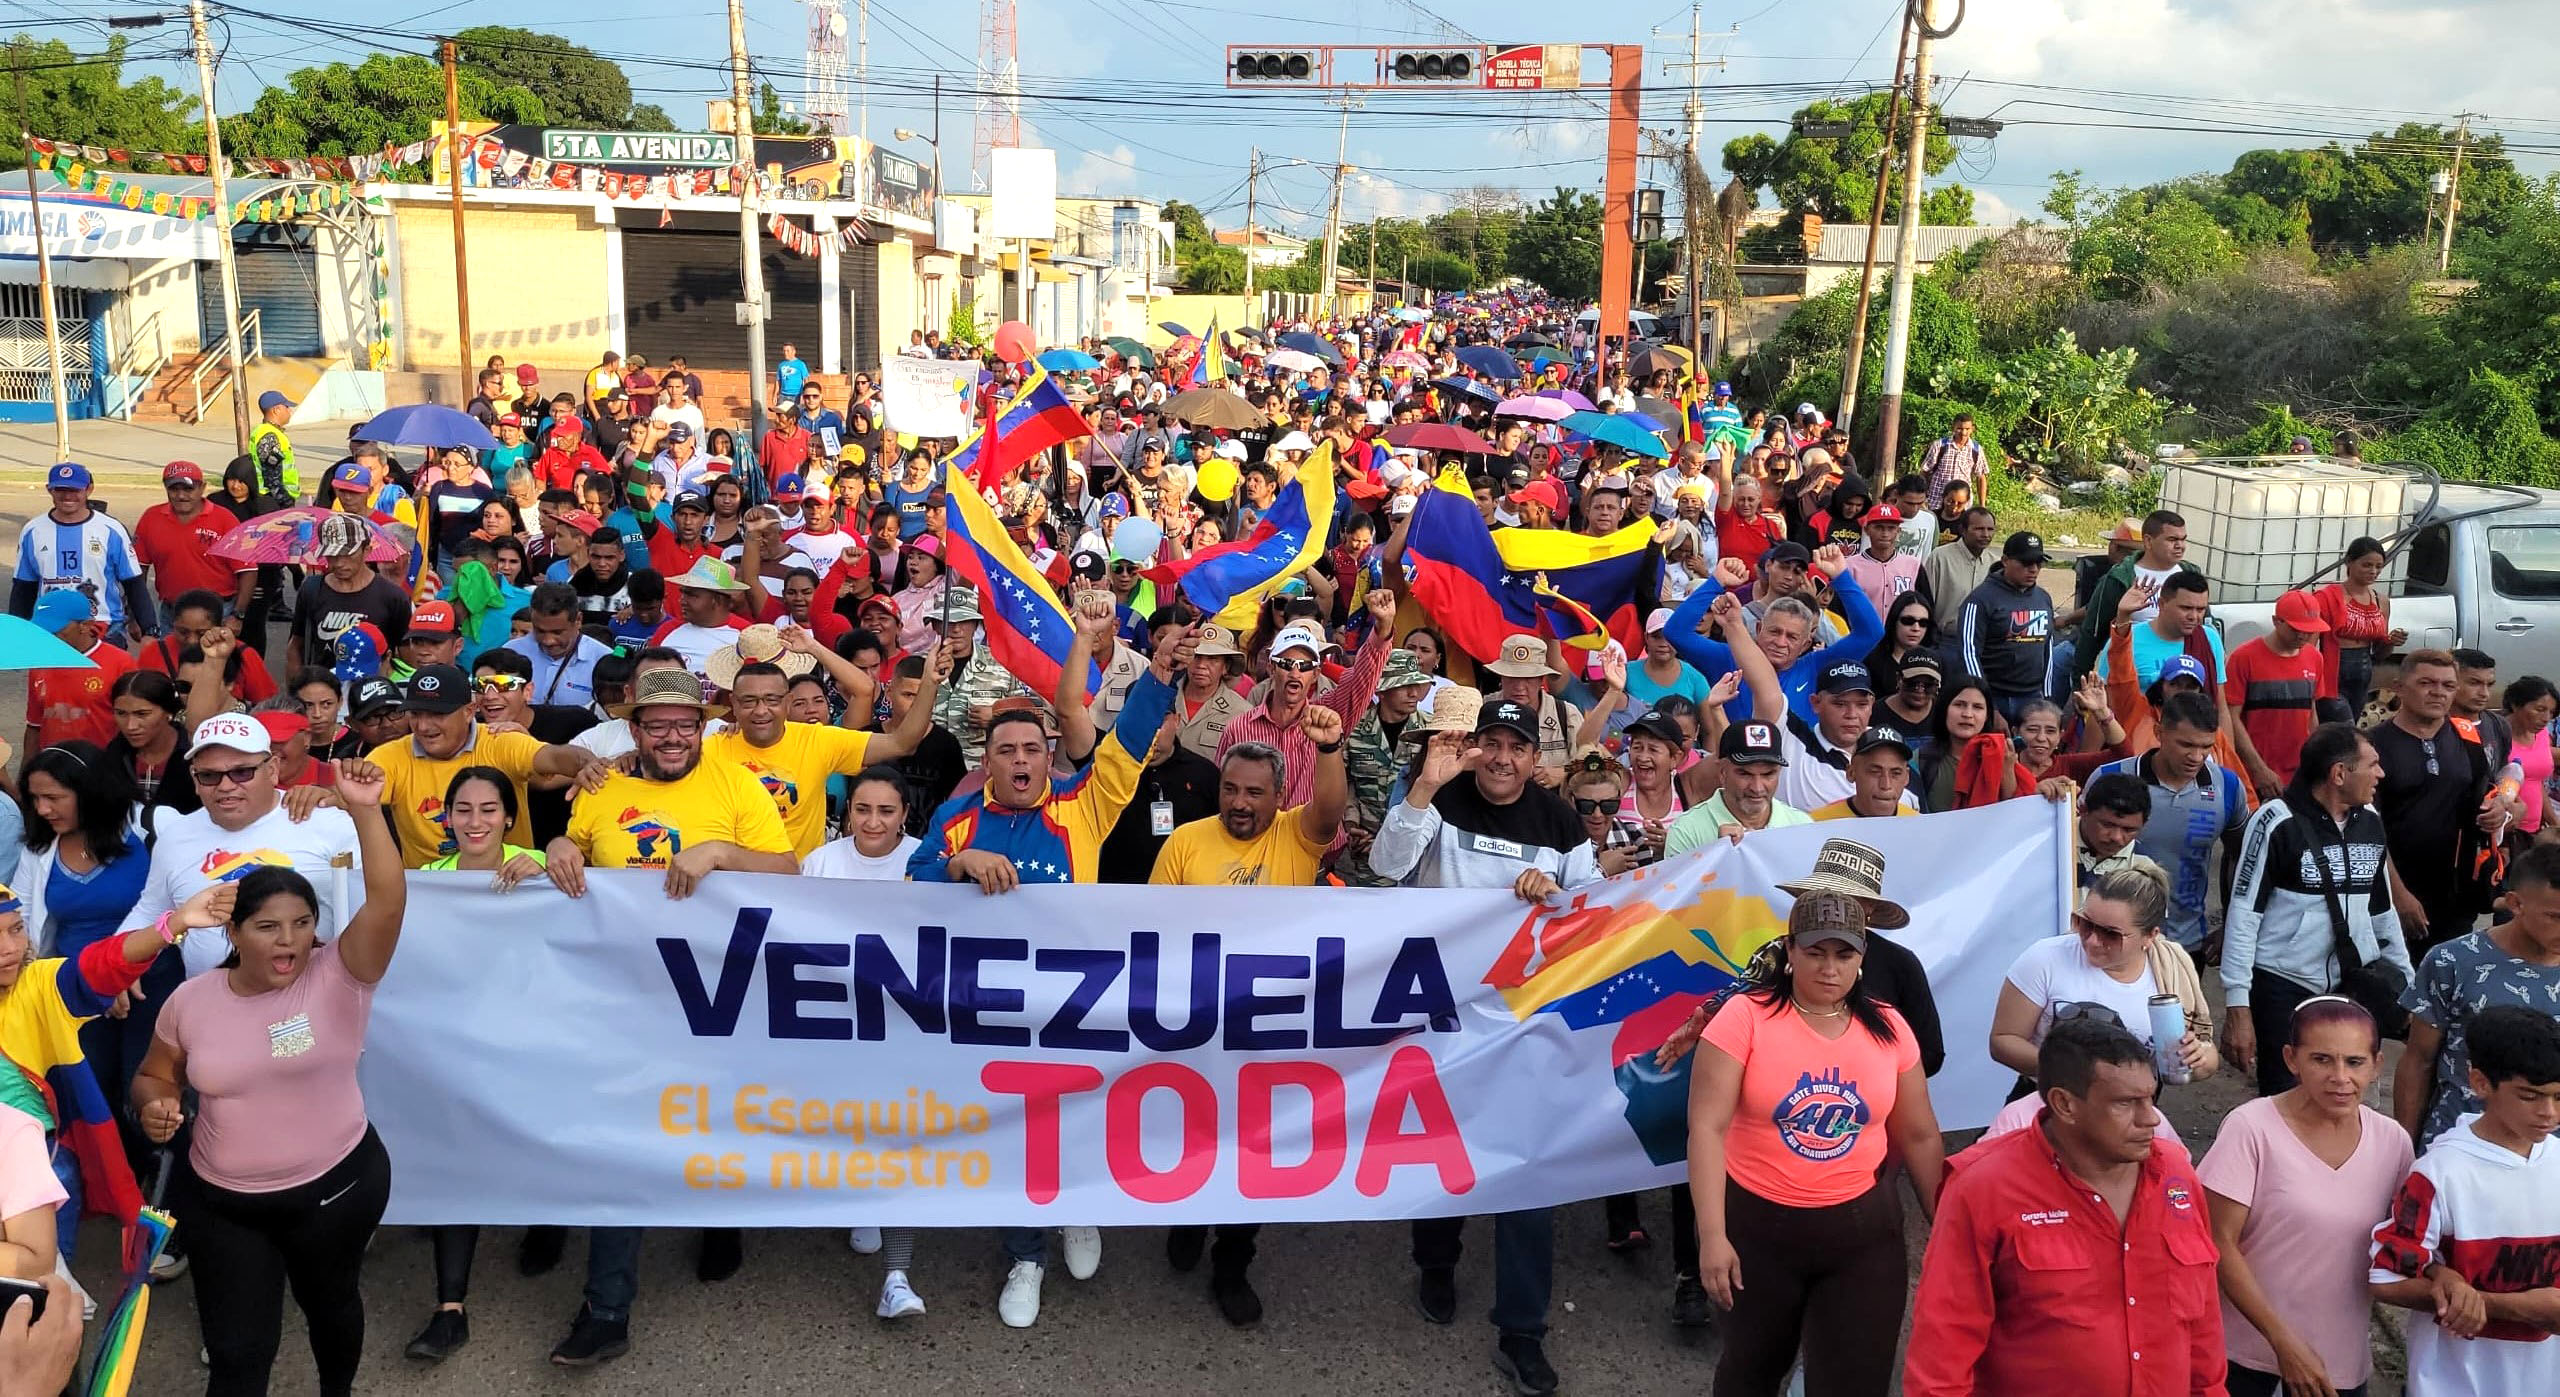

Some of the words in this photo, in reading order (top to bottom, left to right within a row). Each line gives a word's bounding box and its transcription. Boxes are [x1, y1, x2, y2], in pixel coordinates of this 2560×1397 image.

[1496, 60, 1517, 68] ESCUELA
[1517, 78, 1534, 87] NUEVO
[552, 136, 603, 158] 5TA
[611, 136, 731, 160] AVENIDA
[61, 550, 78, 570] 13
[1894, 575, 1911, 597] N
[321, 611, 362, 630] NIKE
[2010, 610, 2049, 636] NIKE
[1829, 663, 1868, 677] adidas
[200, 724, 250, 740] DIOS
[1878, 727, 1899, 742] NY
[1478, 840, 1520, 855] adidas
[656, 907, 1460, 1053] VENEZUELA
[1788, 1088, 1812, 1106] GATE
[1812, 1084, 1840, 1095] RIVER
[1842, 1089, 1861, 1107] RUN
[658, 1083, 712, 1137] El
[732, 1084, 992, 1145] Esequibo
[1786, 1102, 1856, 1139] 40
[981, 1045, 1477, 1206] TODA
[682, 1152, 748, 1190] es
[769, 1143, 992, 1190] nuestro
